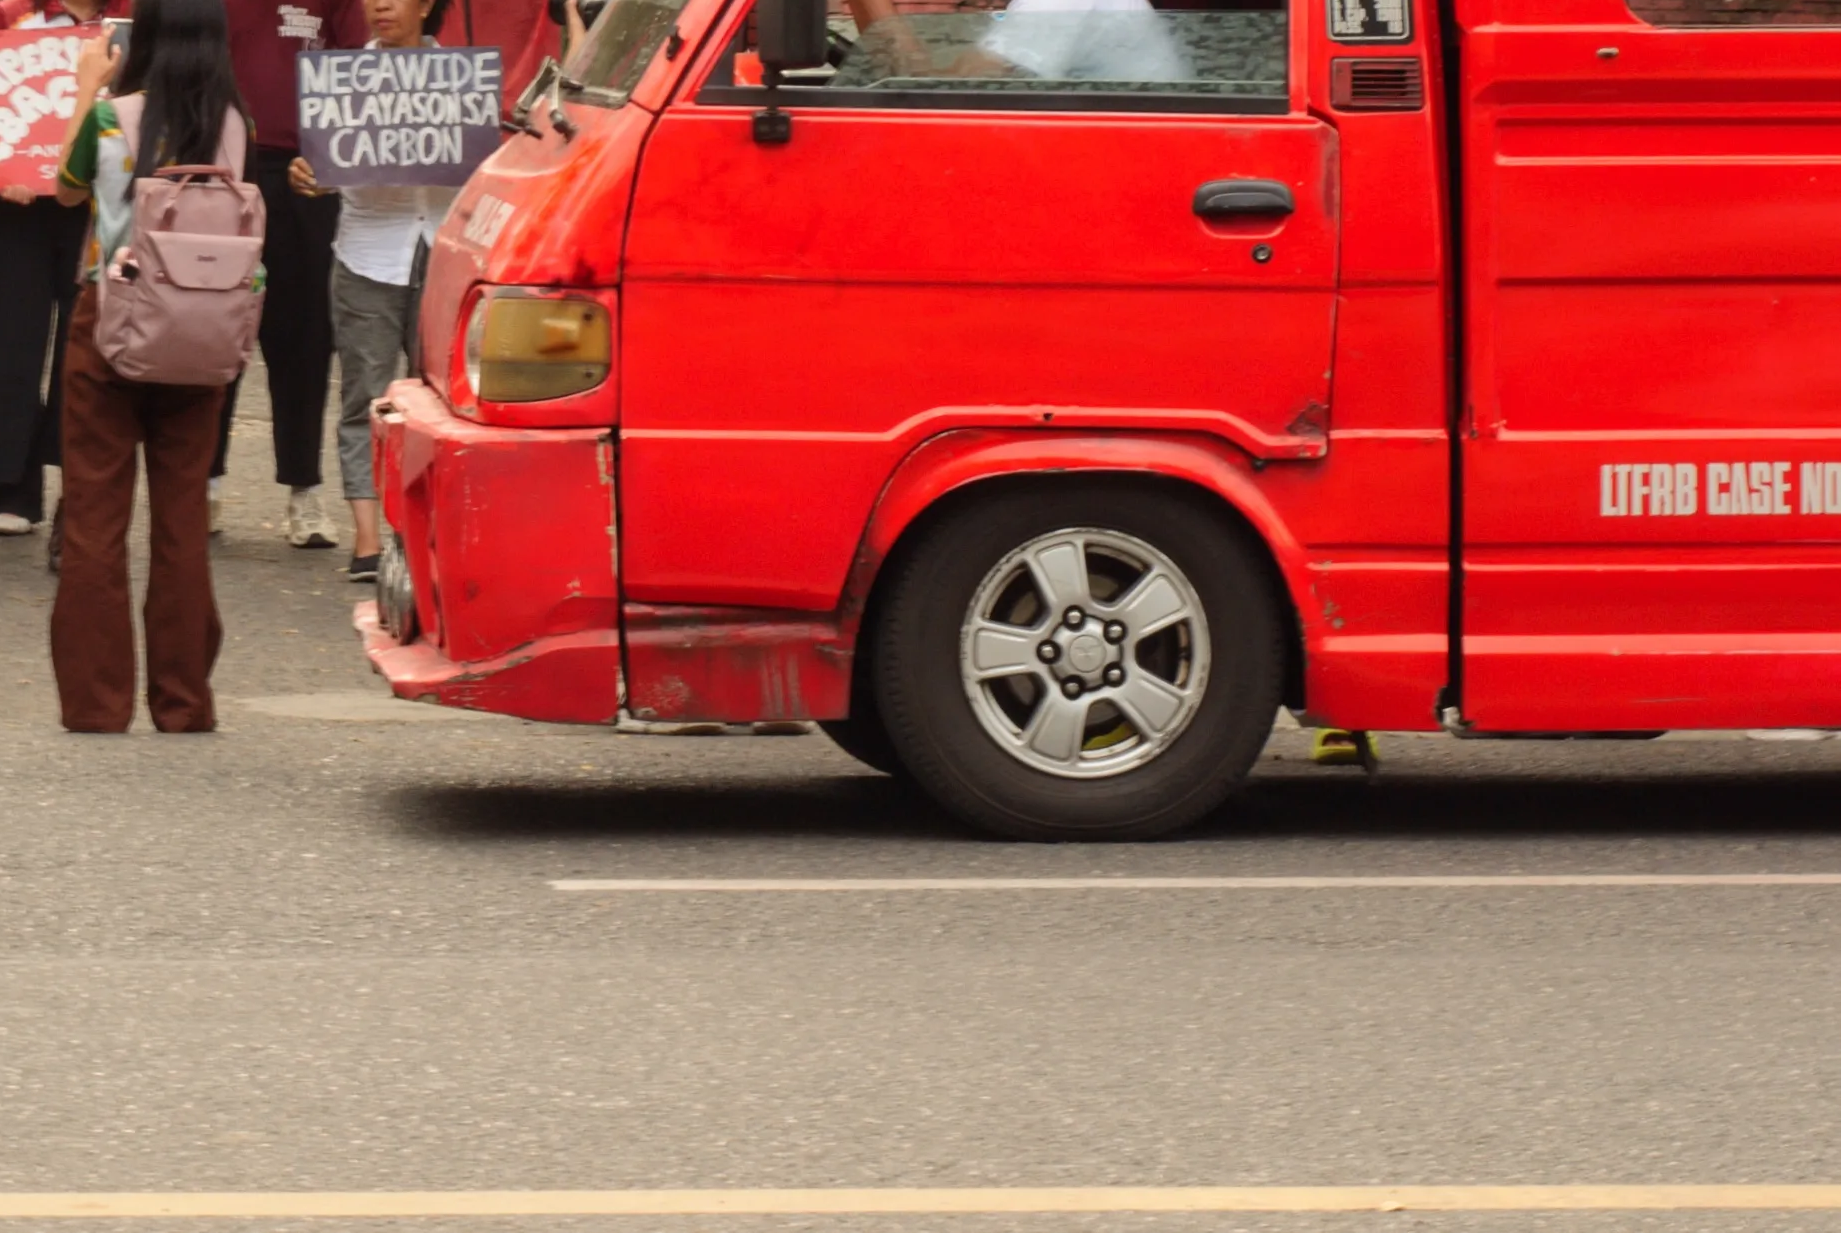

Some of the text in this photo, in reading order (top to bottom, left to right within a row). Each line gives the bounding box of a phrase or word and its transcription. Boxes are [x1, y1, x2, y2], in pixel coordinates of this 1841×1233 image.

[329, 126, 463, 168] CARBON
[1600, 462, 1698, 517] LTFRB
[1706, 461, 1792, 516] CASE
